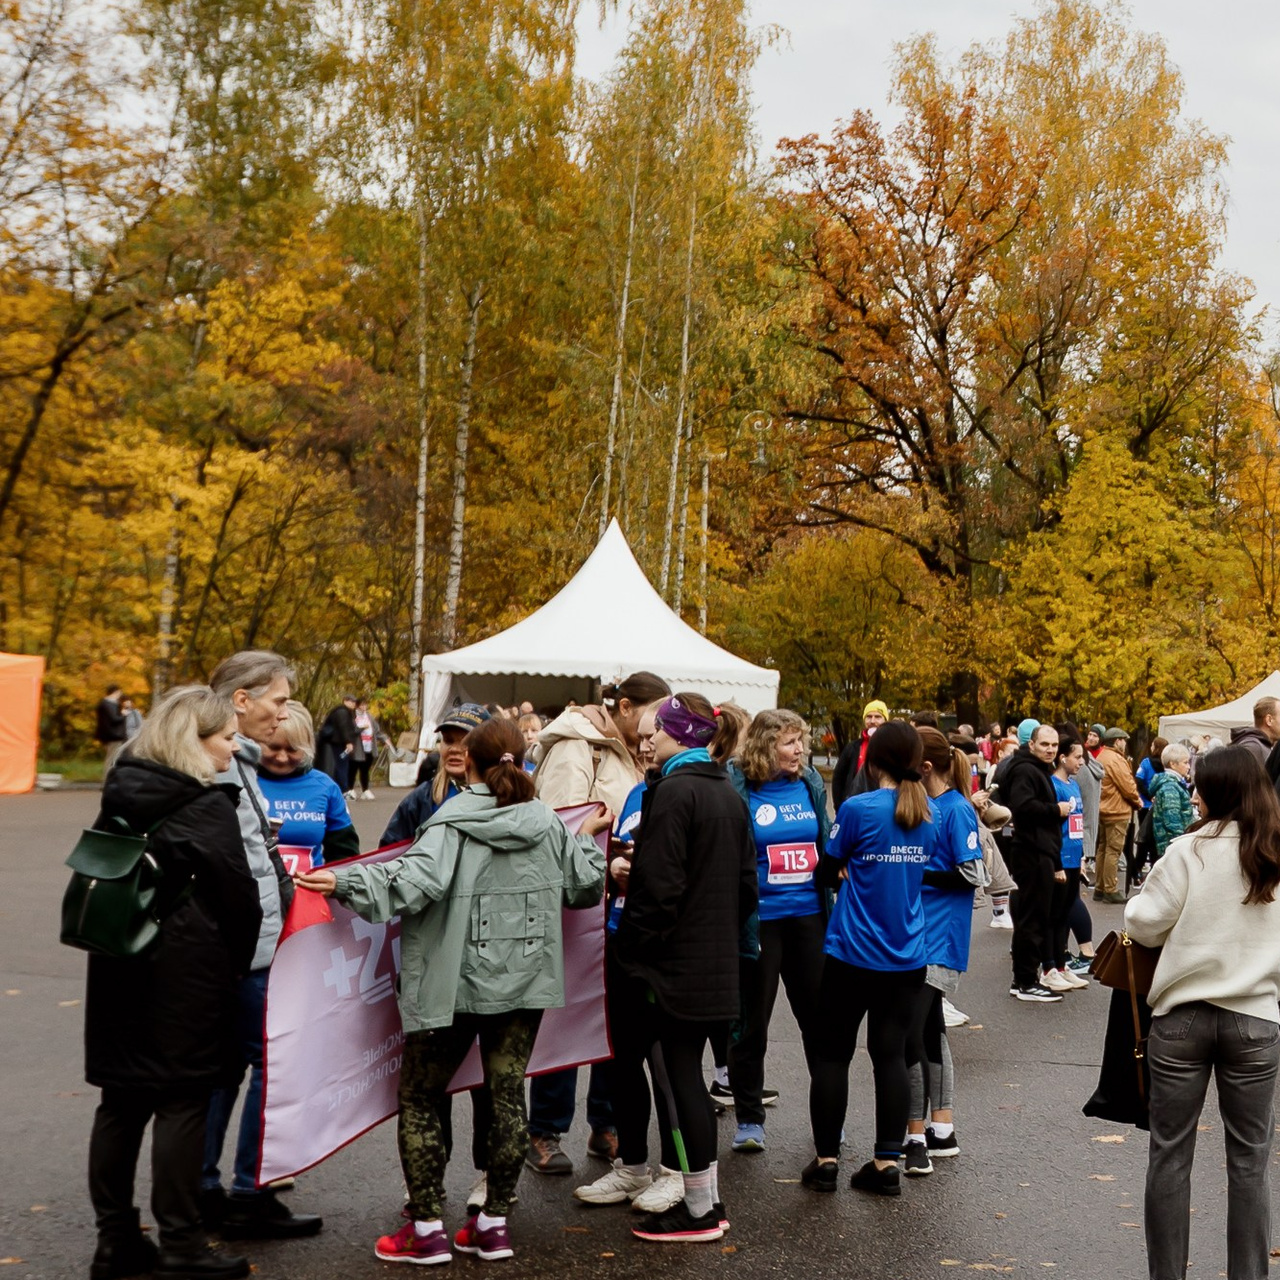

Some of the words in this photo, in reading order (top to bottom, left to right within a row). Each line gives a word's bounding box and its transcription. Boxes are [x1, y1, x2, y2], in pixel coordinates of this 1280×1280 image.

[274, 800, 306, 810] БЕГУ
[779, 803, 802, 814] БЕГУ
[293, 811, 327, 822] ОРБИ
[890, 845, 924, 855] ВМЕСТЕ
[780, 849, 809, 871] 113
